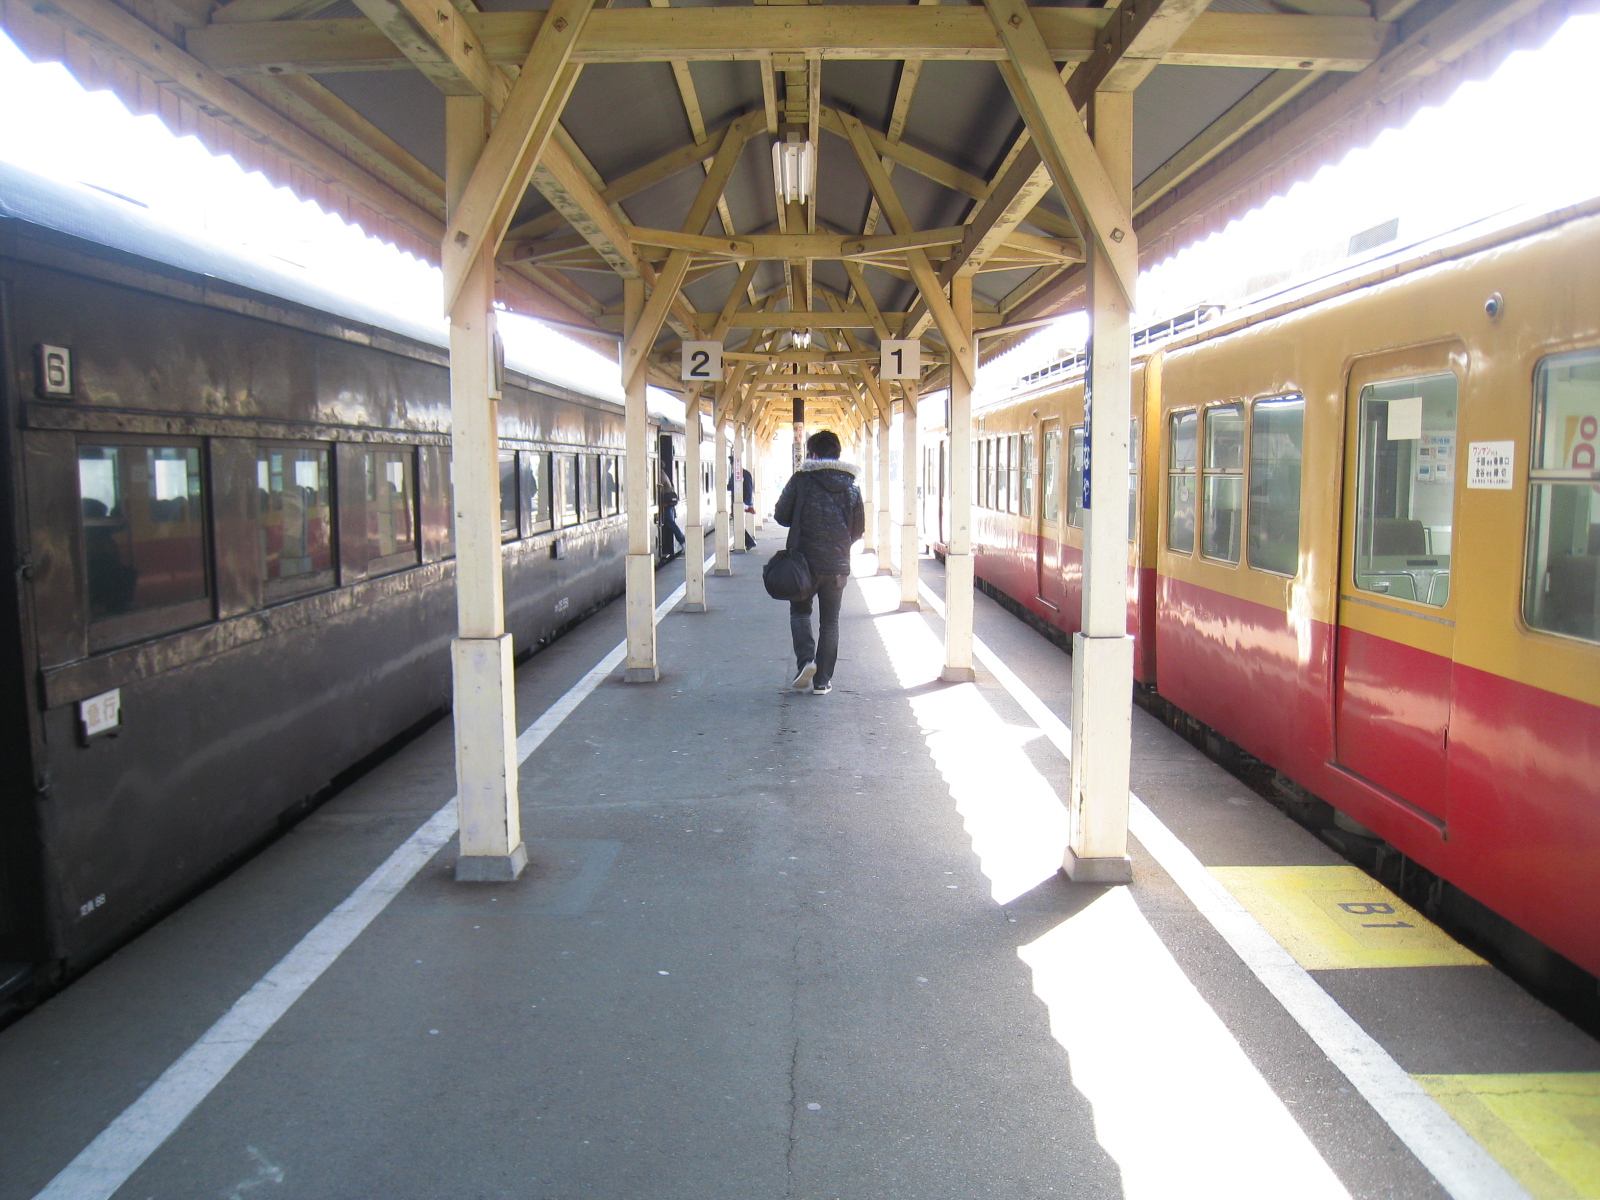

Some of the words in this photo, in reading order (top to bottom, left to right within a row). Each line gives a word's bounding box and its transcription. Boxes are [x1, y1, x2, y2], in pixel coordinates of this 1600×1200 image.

[47, 352, 65, 387] 6
[690, 351, 710, 377] 2
[890, 348, 903, 375] 1
[1337, 902, 1416, 928] B1
